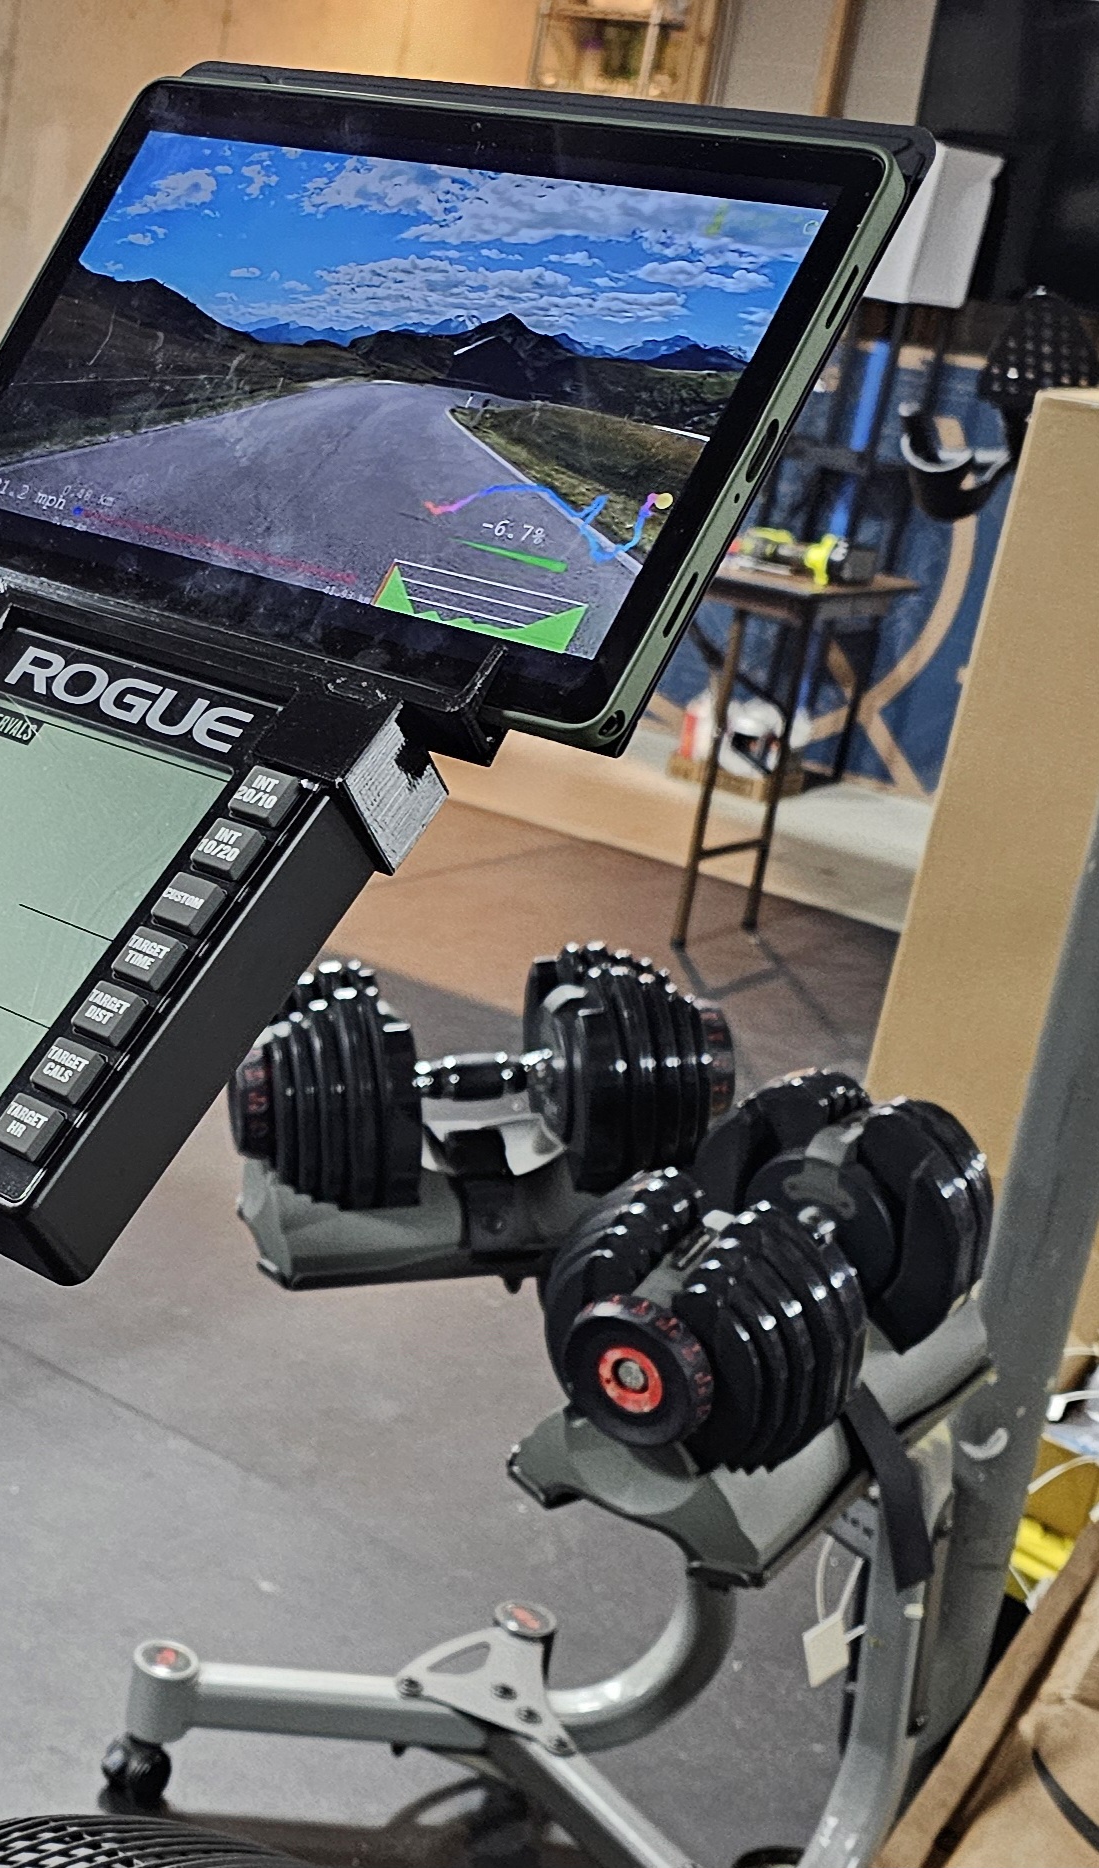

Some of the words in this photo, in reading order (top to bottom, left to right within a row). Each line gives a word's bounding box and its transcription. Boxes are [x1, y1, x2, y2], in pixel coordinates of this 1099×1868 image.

[33, 491, 67, 510] mph
[482, 519, 547, 545] -6.7%
[4, 645, 254, 753] ROGUE
[251, 774, 279, 793] INT
[233, 785, 278, 809] 20/10
[214, 826, 242, 845] INT
[198, 838, 240, 862] 10/20
[162, 887, 204, 910] CUSTOM
[128, 934, 170, 959] TARGET
[125, 949, 155, 970] TIME
[88, 988, 131, 1015] TARGET
[84, 1004, 114, 1025] DIST
[47, 1045, 90, 1072] TARGET
[42, 1061, 73, 1083] CALS
[6, 1101, 49, 1129] TARGET
[6, 1120, 26, 1138] HR
